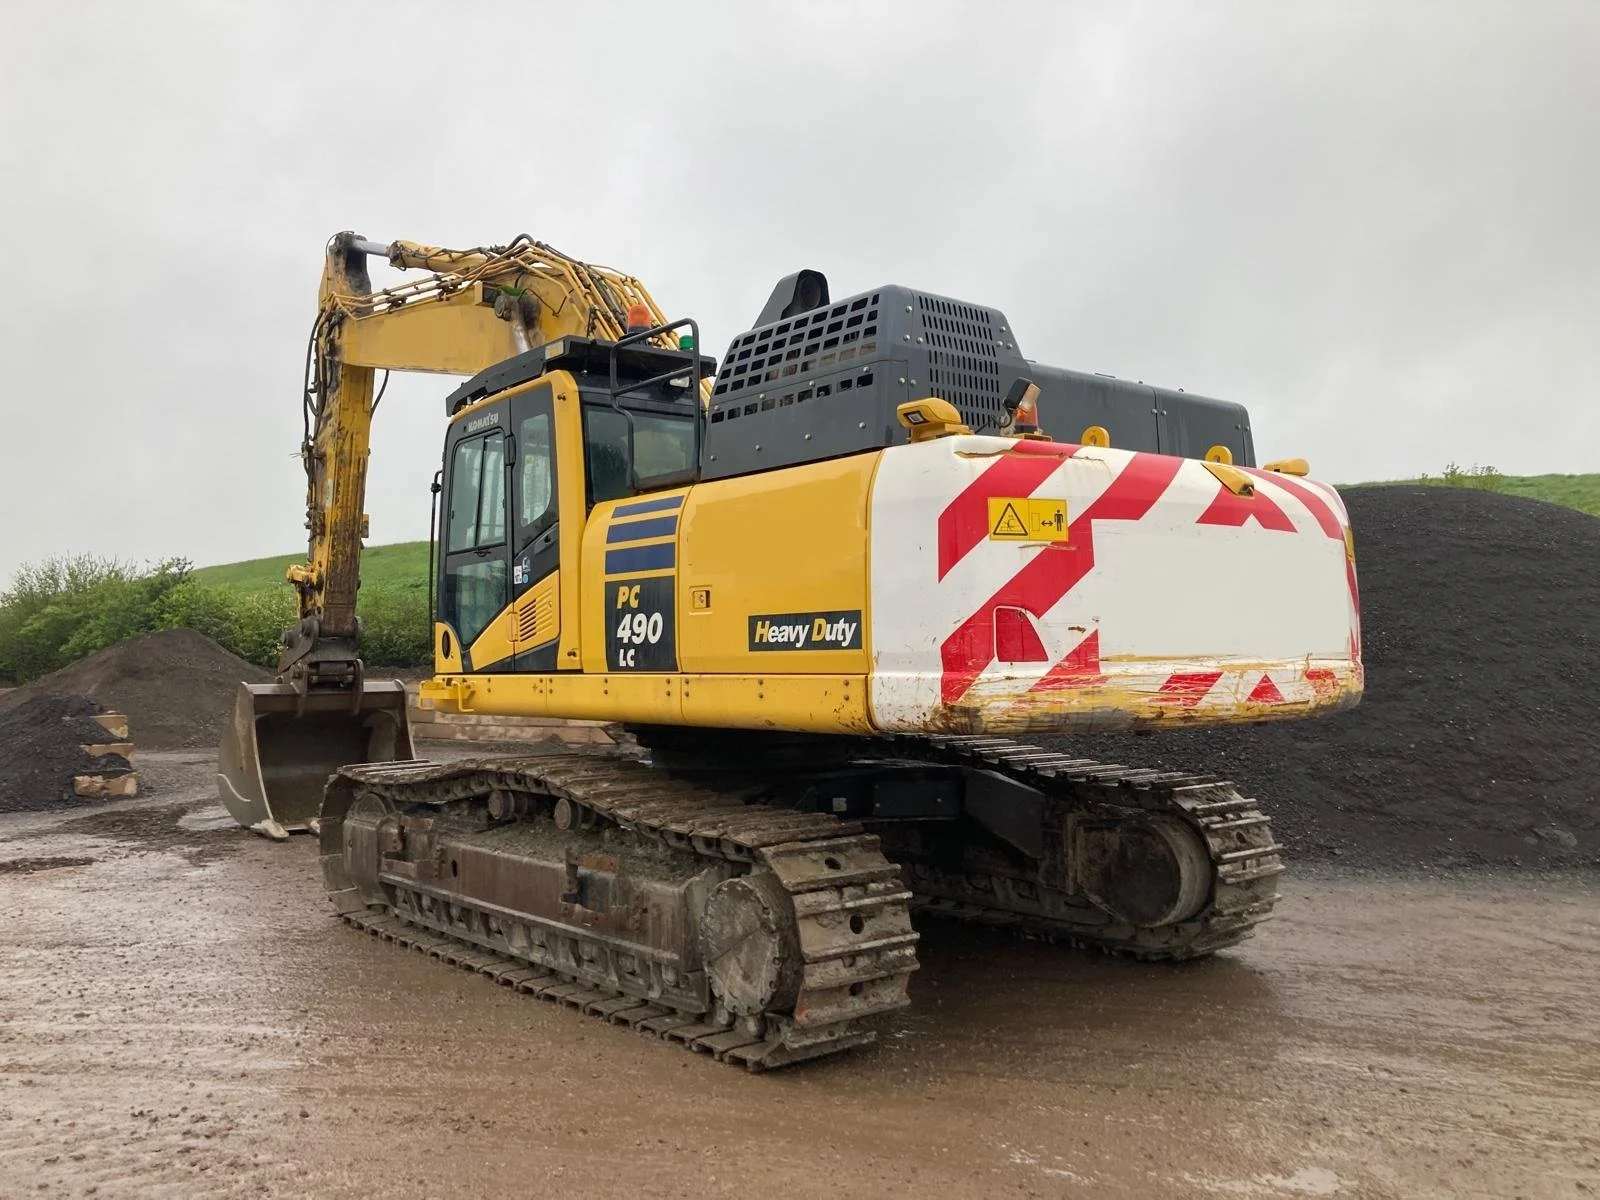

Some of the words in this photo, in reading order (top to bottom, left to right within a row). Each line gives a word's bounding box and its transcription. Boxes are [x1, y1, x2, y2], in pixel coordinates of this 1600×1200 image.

[468, 412, 499, 432] KOMATSU
[617, 585, 641, 609] PC
[617, 612, 663, 645] 490
[755, 620, 809, 647] Heavy
[811, 617, 857, 646] Duty
[619, 648, 635, 667] LC
